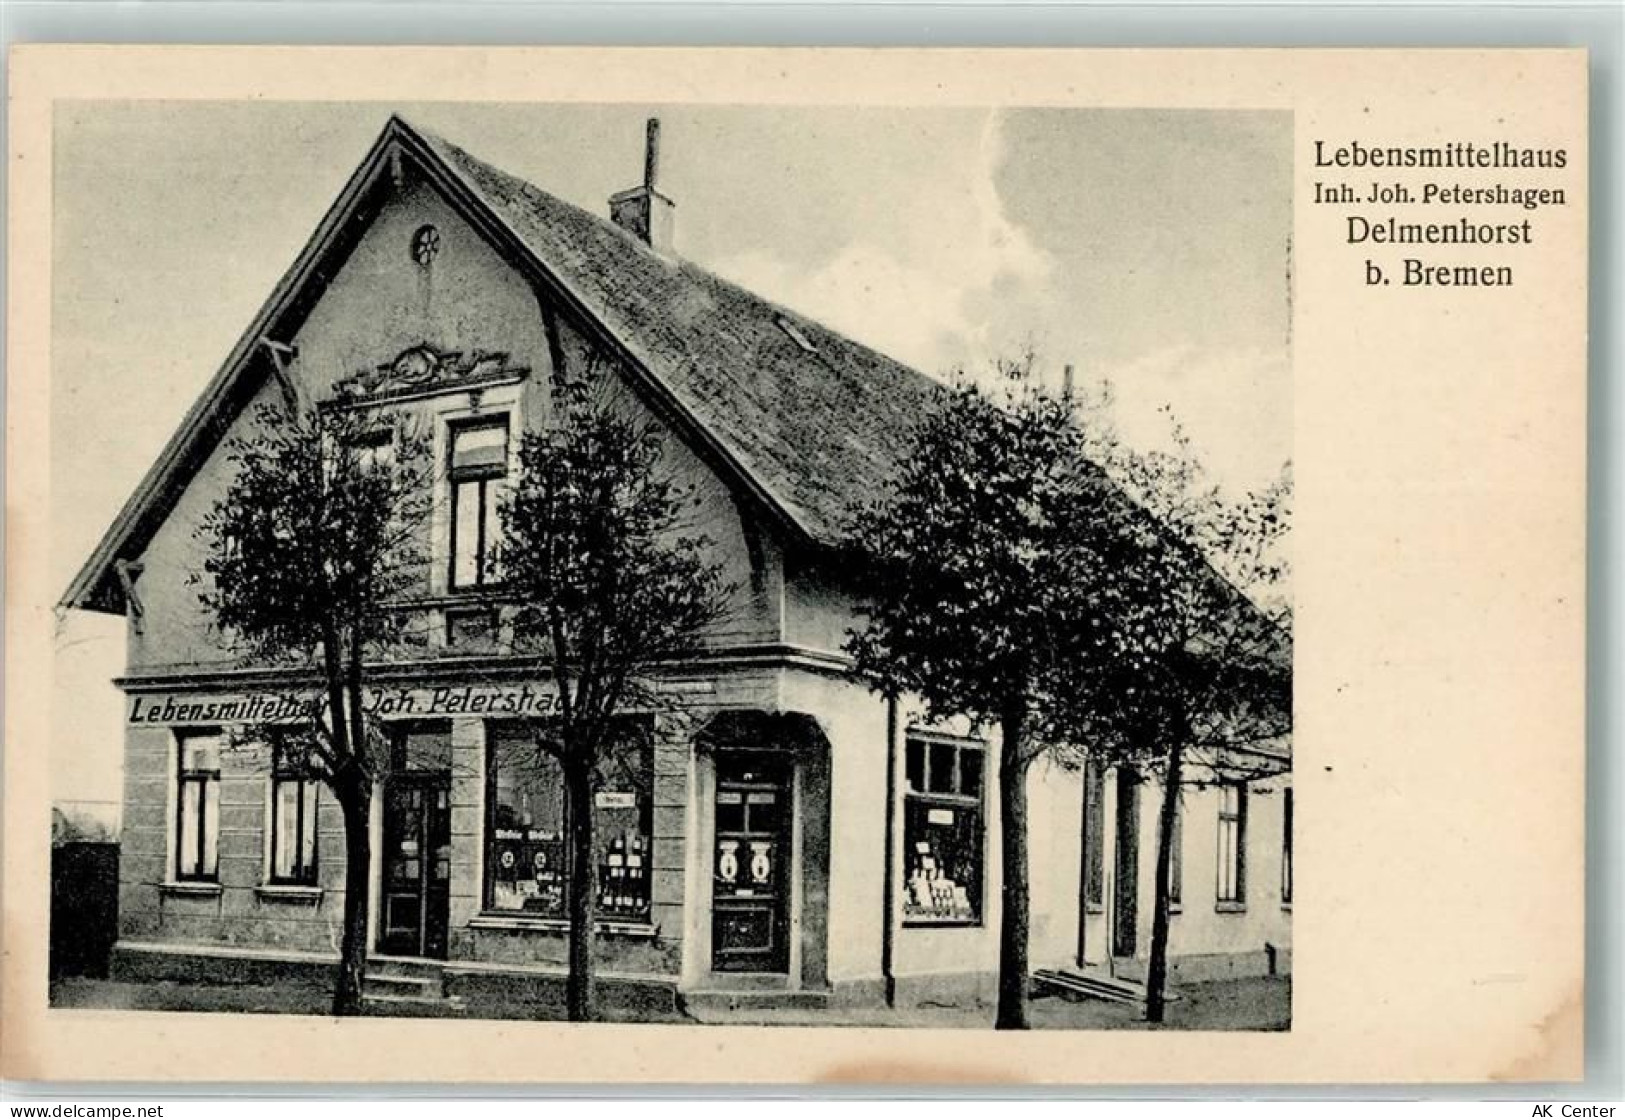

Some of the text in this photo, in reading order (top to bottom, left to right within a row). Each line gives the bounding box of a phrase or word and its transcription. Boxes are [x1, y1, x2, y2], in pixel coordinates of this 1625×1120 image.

[1314, 140, 1567, 168] Lebensmittelhaus
[1314, 183, 1566, 209] Inh. Joh. Petershagen
[1347, 216, 1532, 244] Delmenhorst
[1366, 259, 1513, 286] b. Bremen
[361, 685, 422, 714] Joh.
